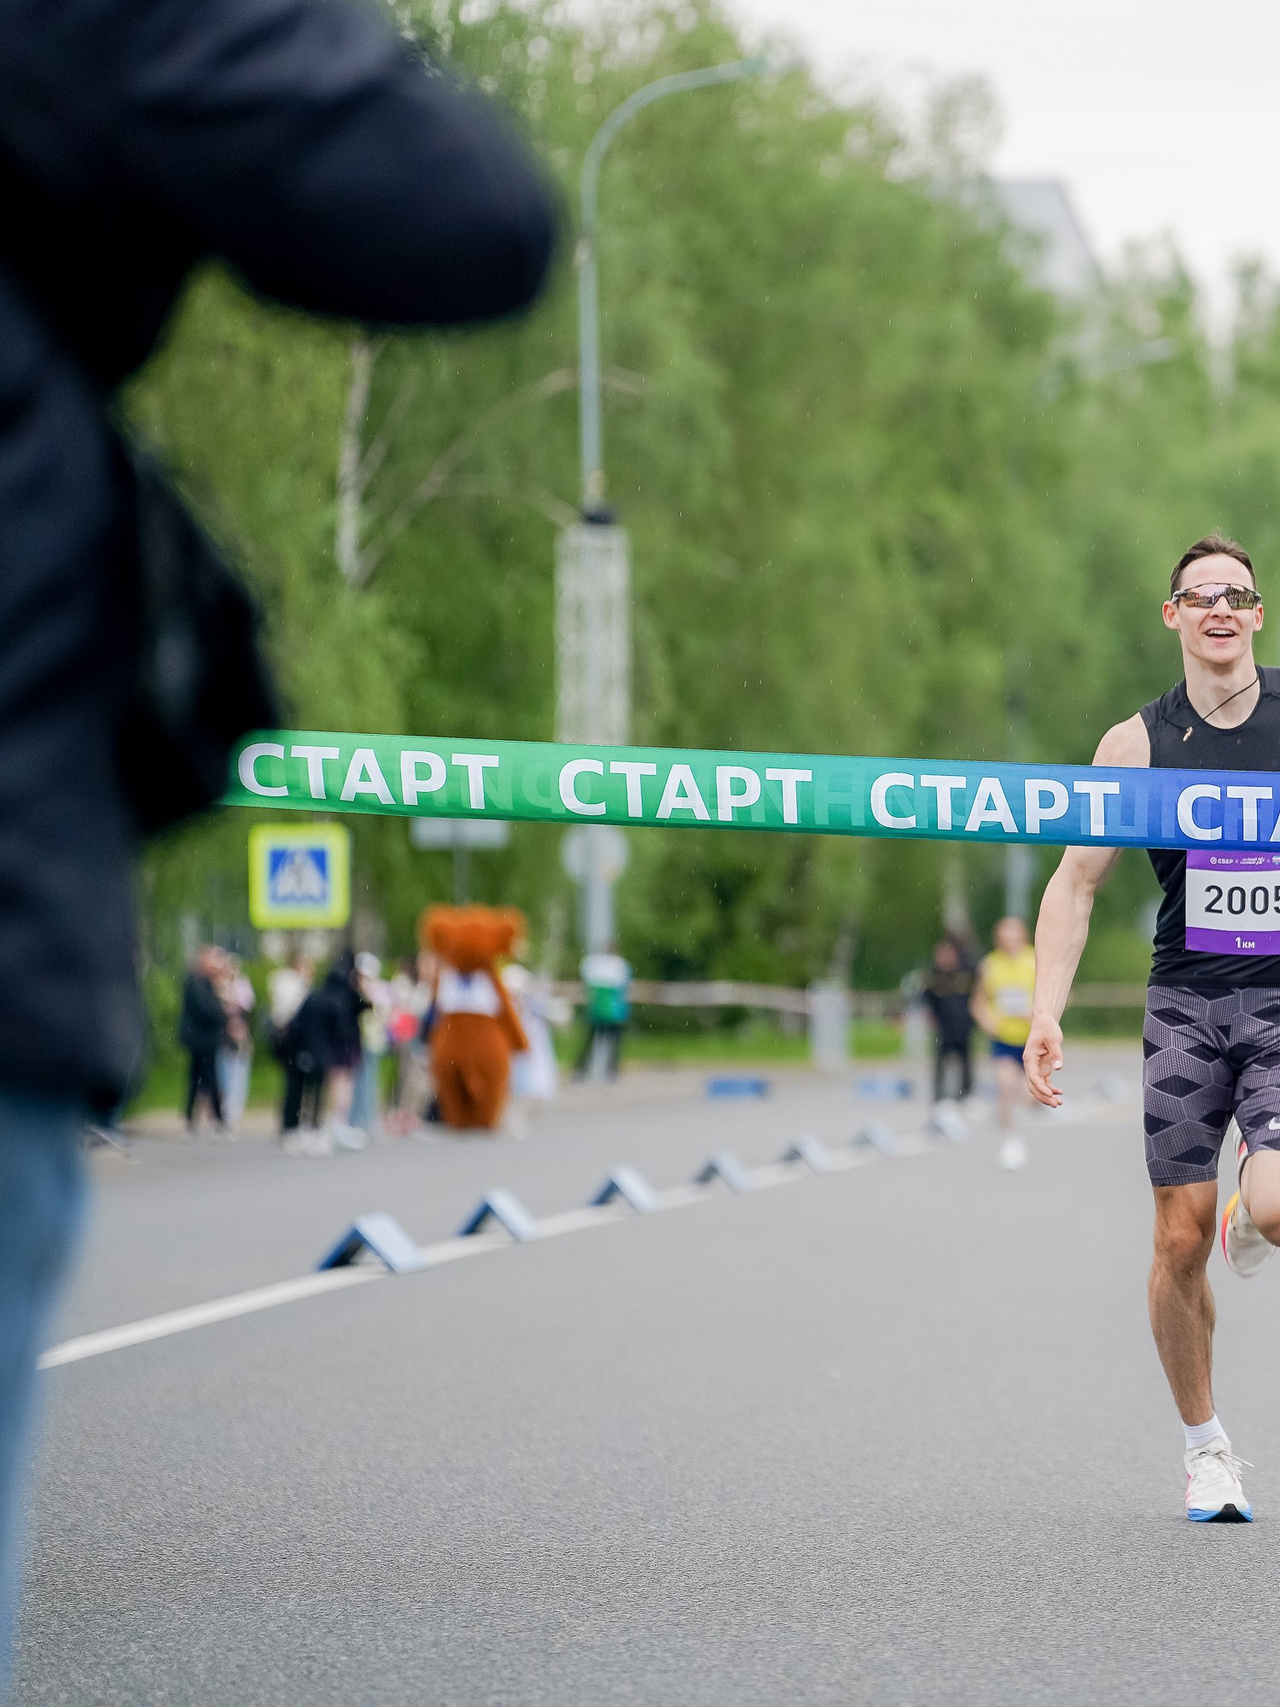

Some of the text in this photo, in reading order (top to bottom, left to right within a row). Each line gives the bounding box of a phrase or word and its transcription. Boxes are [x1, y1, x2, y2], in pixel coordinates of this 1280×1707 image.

[238, 743, 499, 810] СТАРТ
[558, 759, 812, 825] СТАРТ
[871, 772, 1120, 837] СТАРТ
